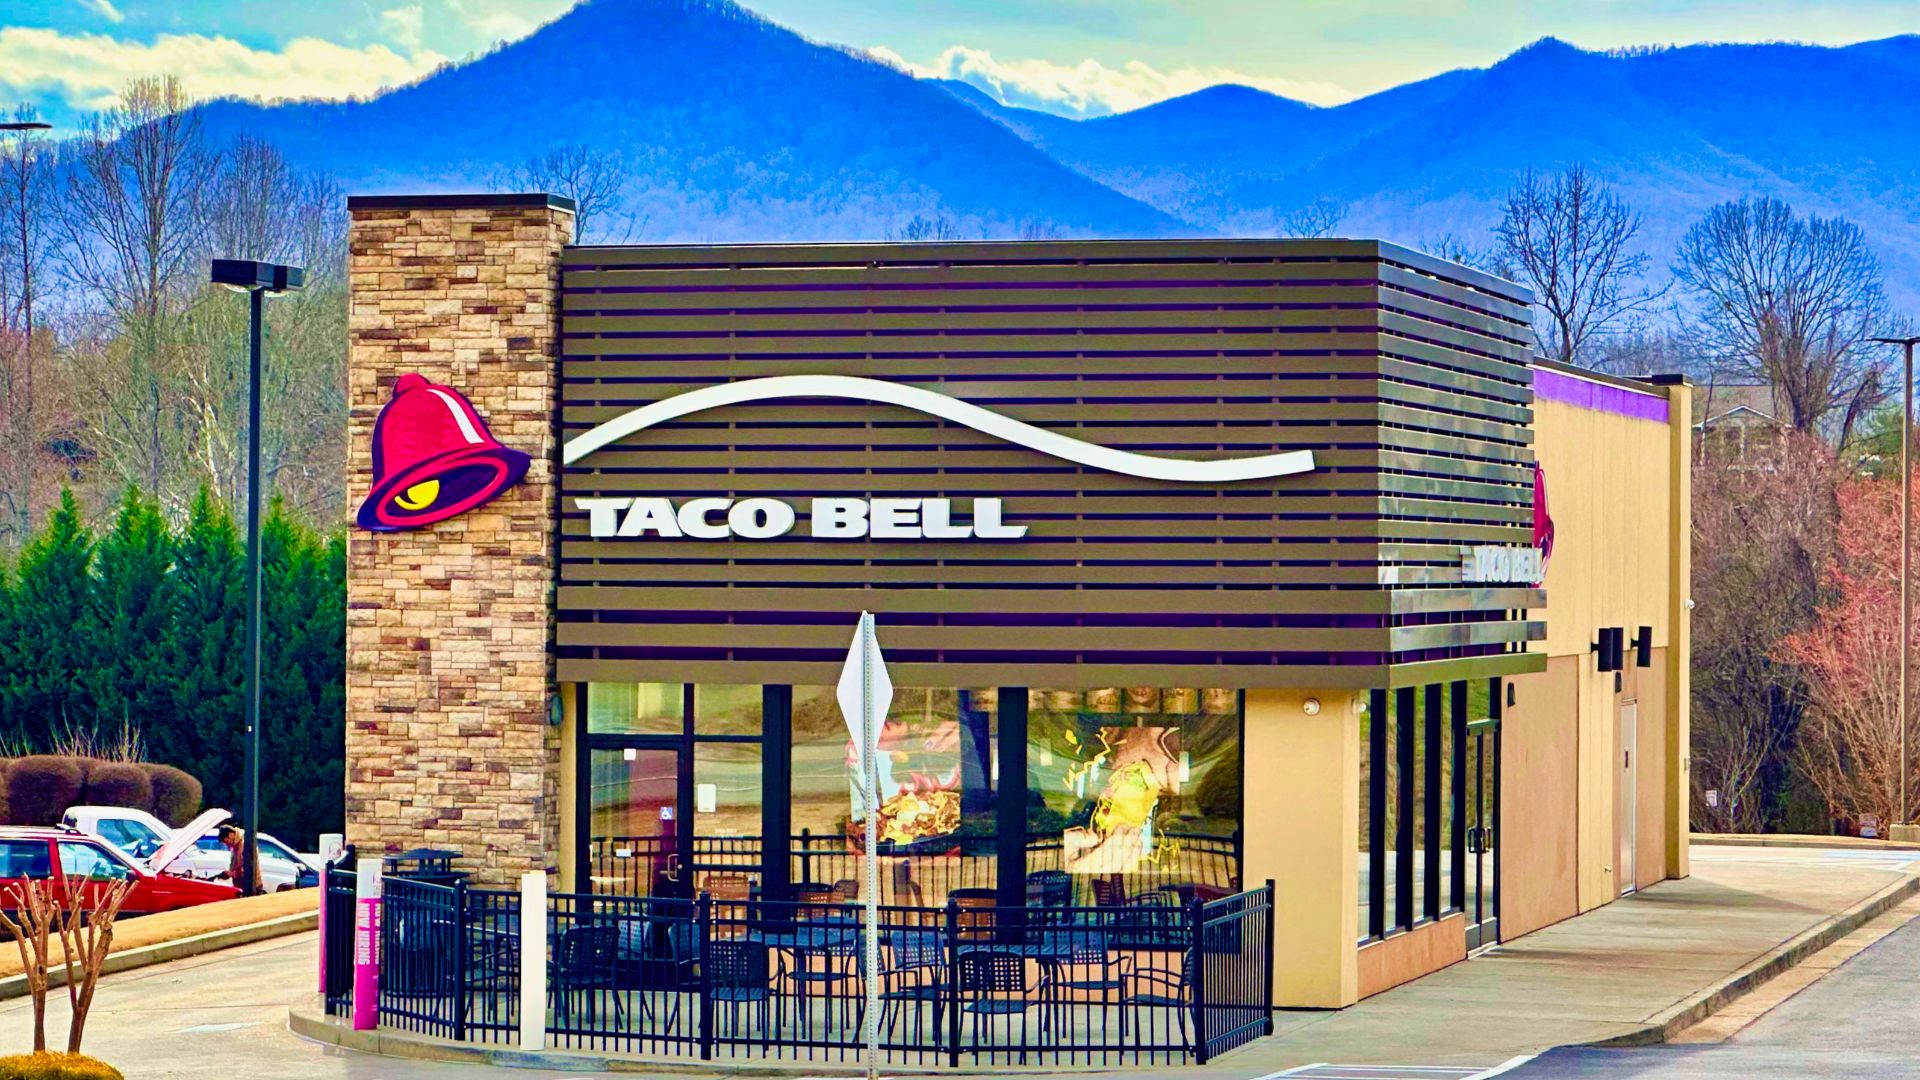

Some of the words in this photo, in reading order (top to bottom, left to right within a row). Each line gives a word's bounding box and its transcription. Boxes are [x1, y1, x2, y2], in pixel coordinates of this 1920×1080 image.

[575, 497, 796, 539] TACO
[811, 497, 1028, 539] BELL
[357, 903, 371, 928] NOW
[357, 930, 371, 966] HIRING
